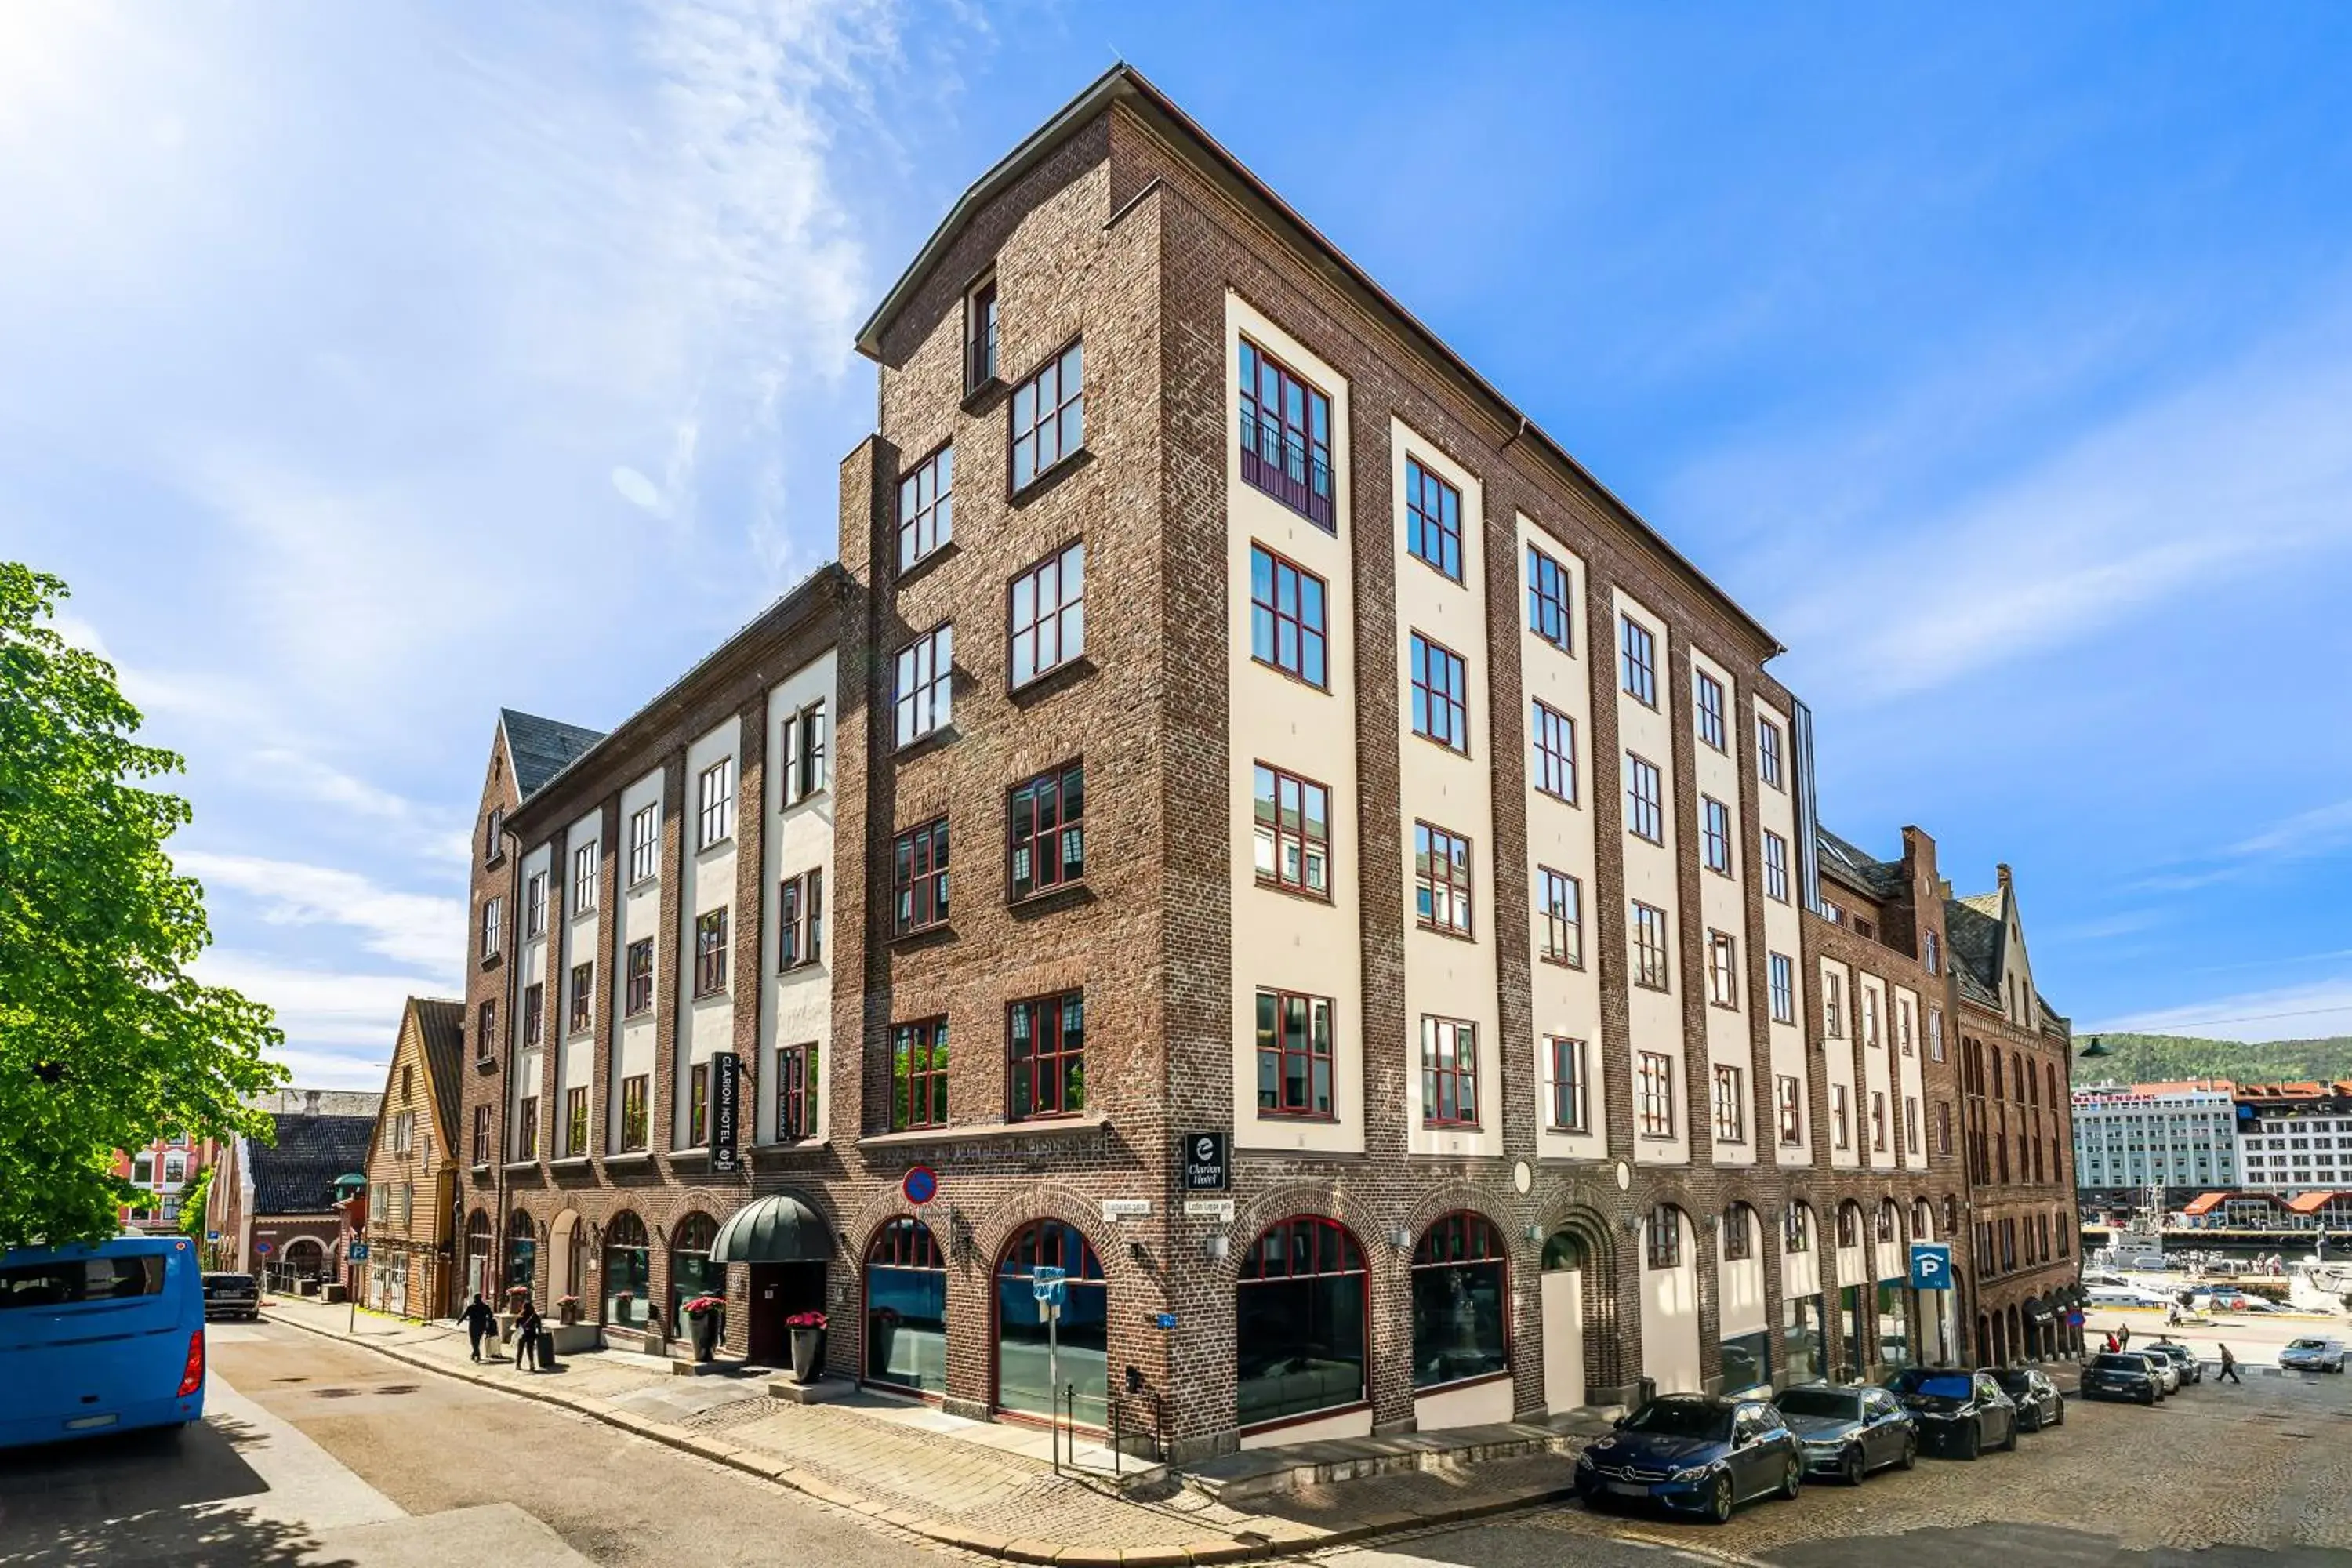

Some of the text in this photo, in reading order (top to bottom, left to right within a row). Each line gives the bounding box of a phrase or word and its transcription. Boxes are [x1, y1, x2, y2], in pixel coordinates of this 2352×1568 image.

[720, 1056, 731, 1142] CLARION HOTEL
[1189, 1163, 1221, 1174] Clarion
[1193, 1174, 1217, 1185] Hotel
[1922, 1260, 1939, 1277] P
